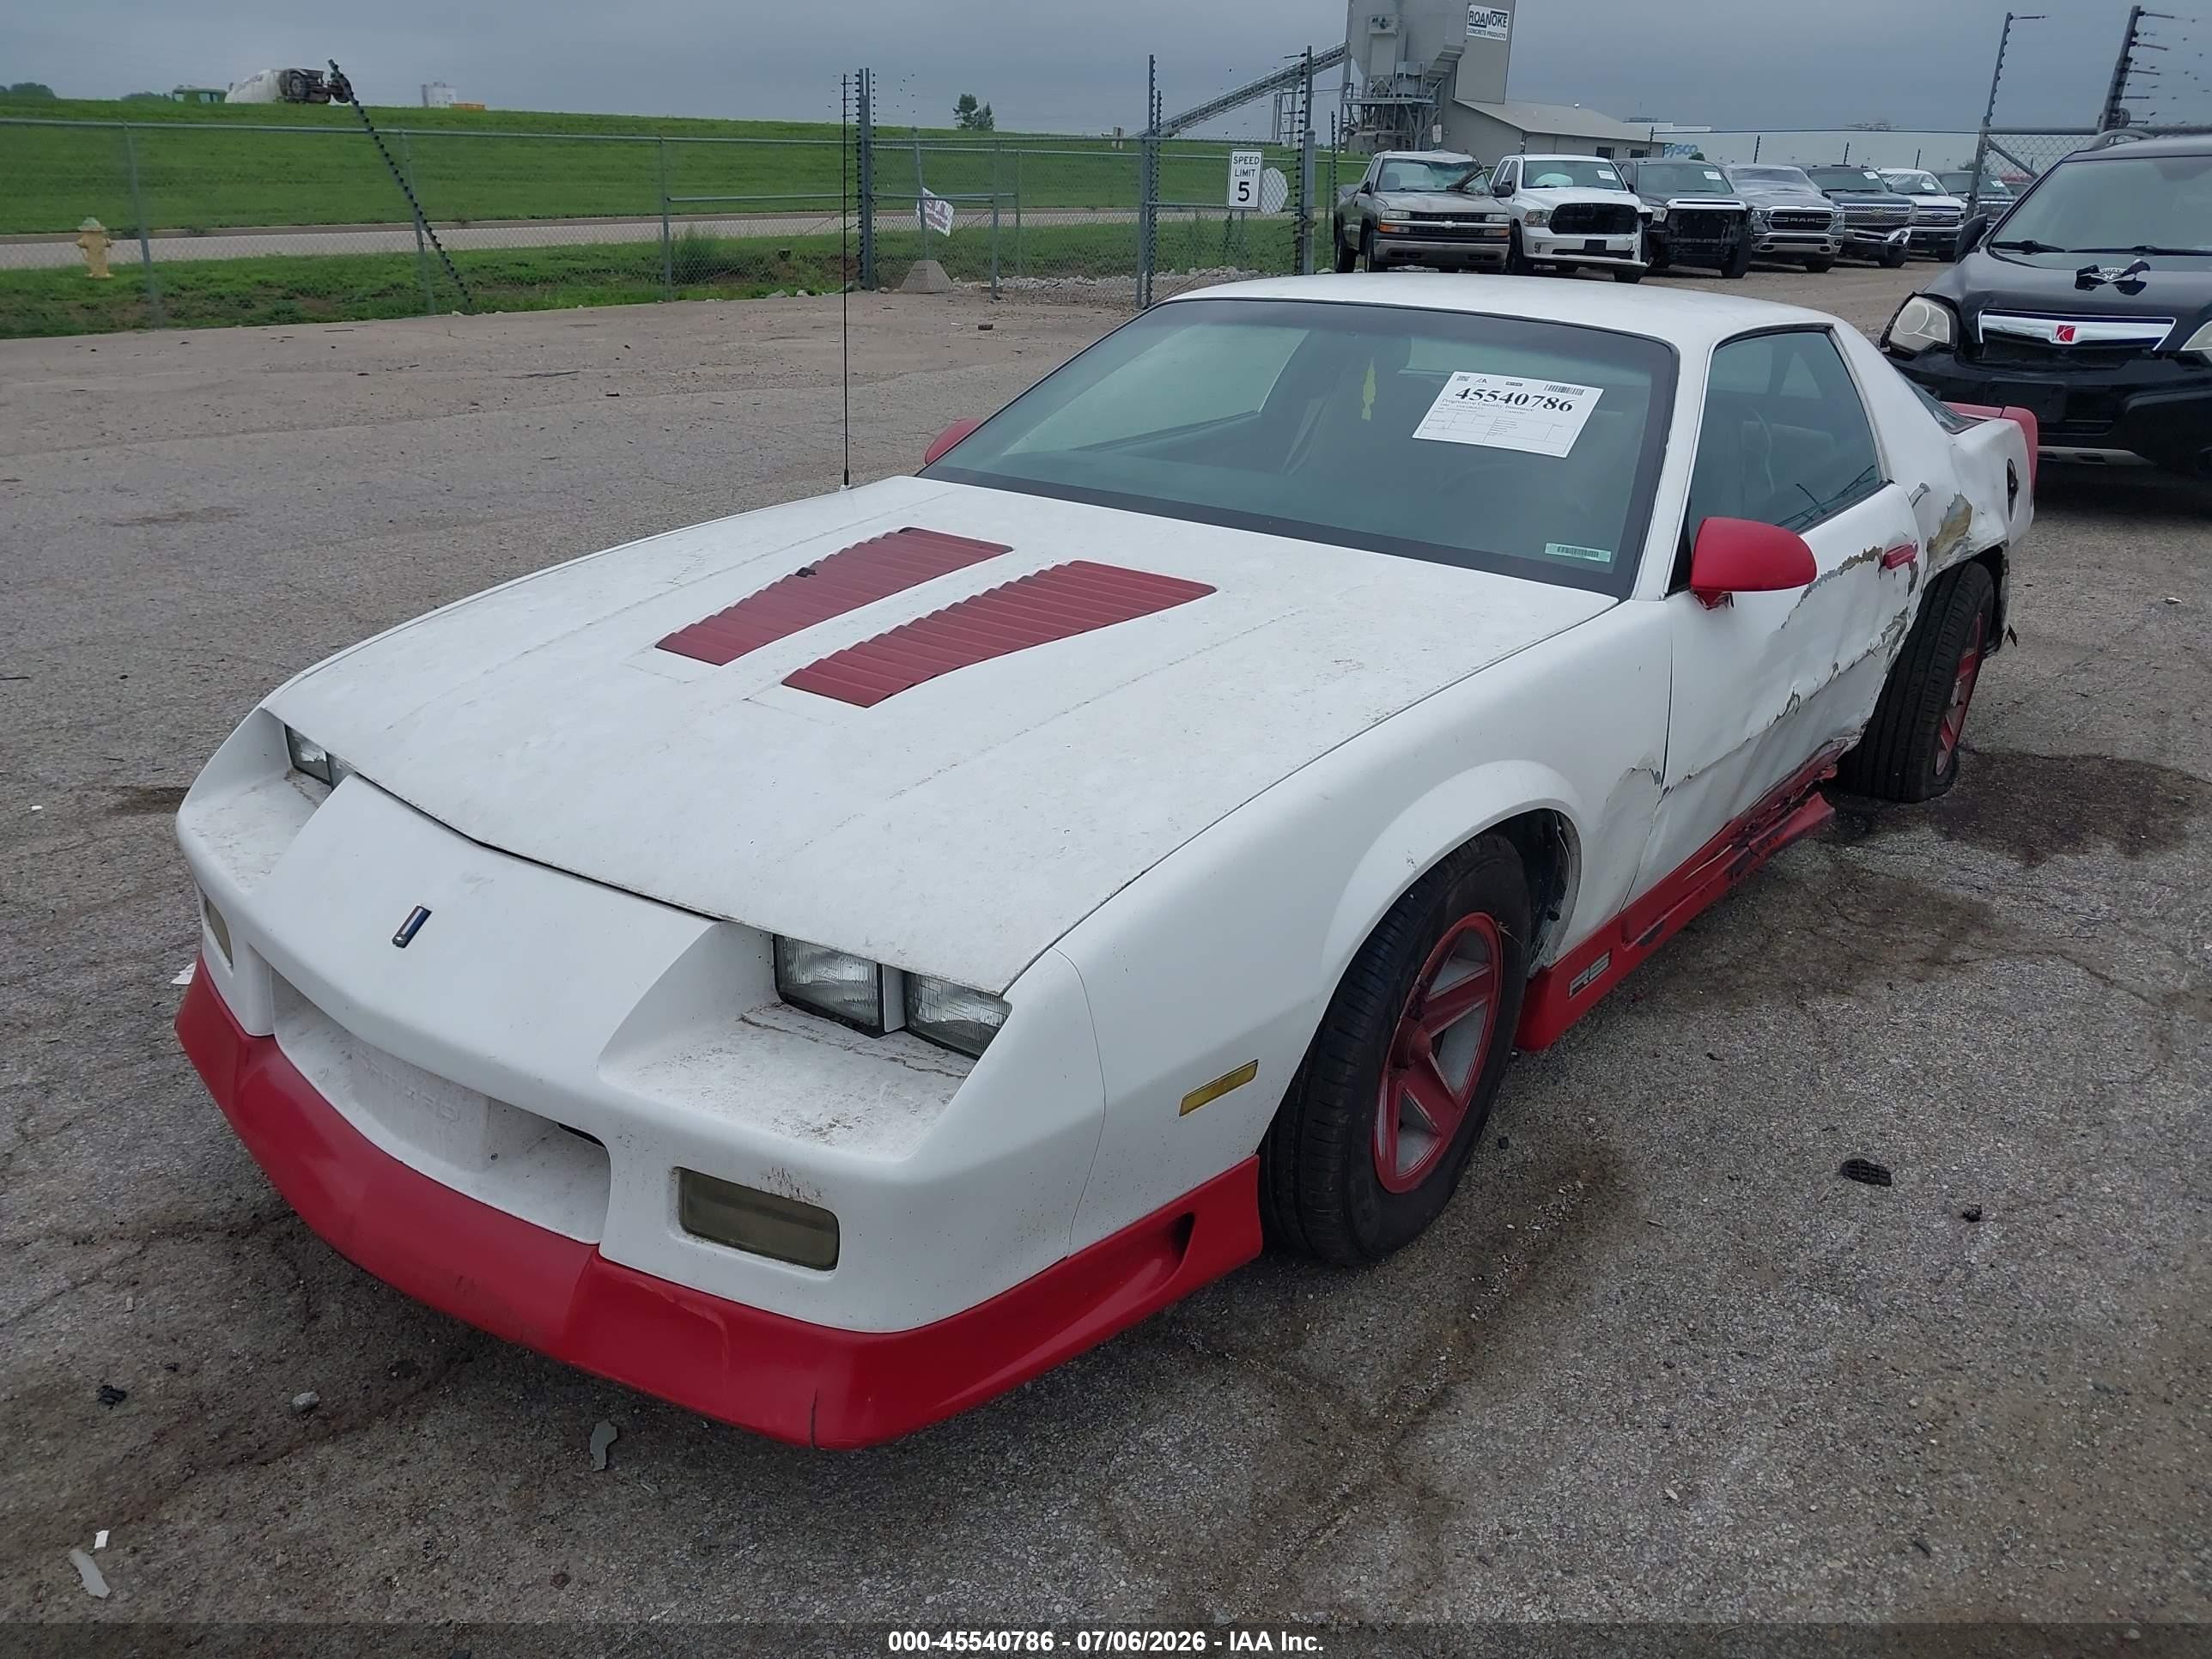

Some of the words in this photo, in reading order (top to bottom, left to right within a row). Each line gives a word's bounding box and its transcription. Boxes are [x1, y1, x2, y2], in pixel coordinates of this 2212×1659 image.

[1468, 10, 1507, 27] ROANOKE
[1233, 156, 1260, 165] SPEED
[1237, 181, 1250, 202] 5
[1455, 387, 1577, 412] 45540786
[1567, 950, 1611, 999] RS
